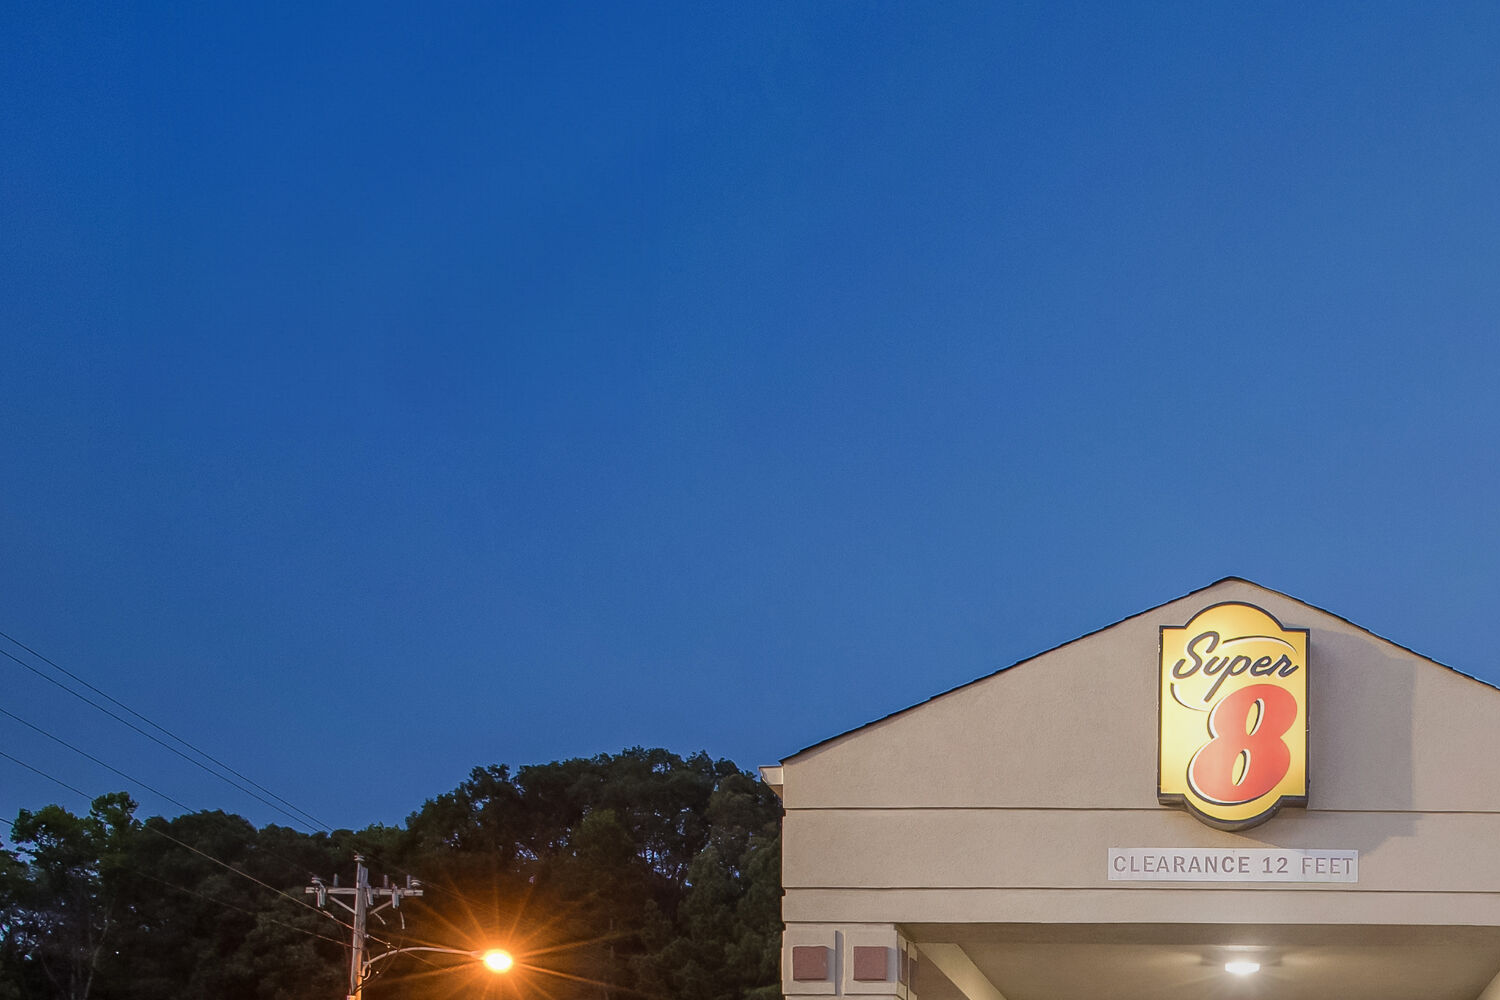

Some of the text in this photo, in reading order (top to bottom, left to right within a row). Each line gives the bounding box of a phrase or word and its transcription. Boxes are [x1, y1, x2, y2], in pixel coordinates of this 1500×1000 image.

[1172, 631, 1299, 703] Super
[1187, 683, 1298, 806] 8
[1113, 855, 1354, 875] CLEARANCE 12 FEET
